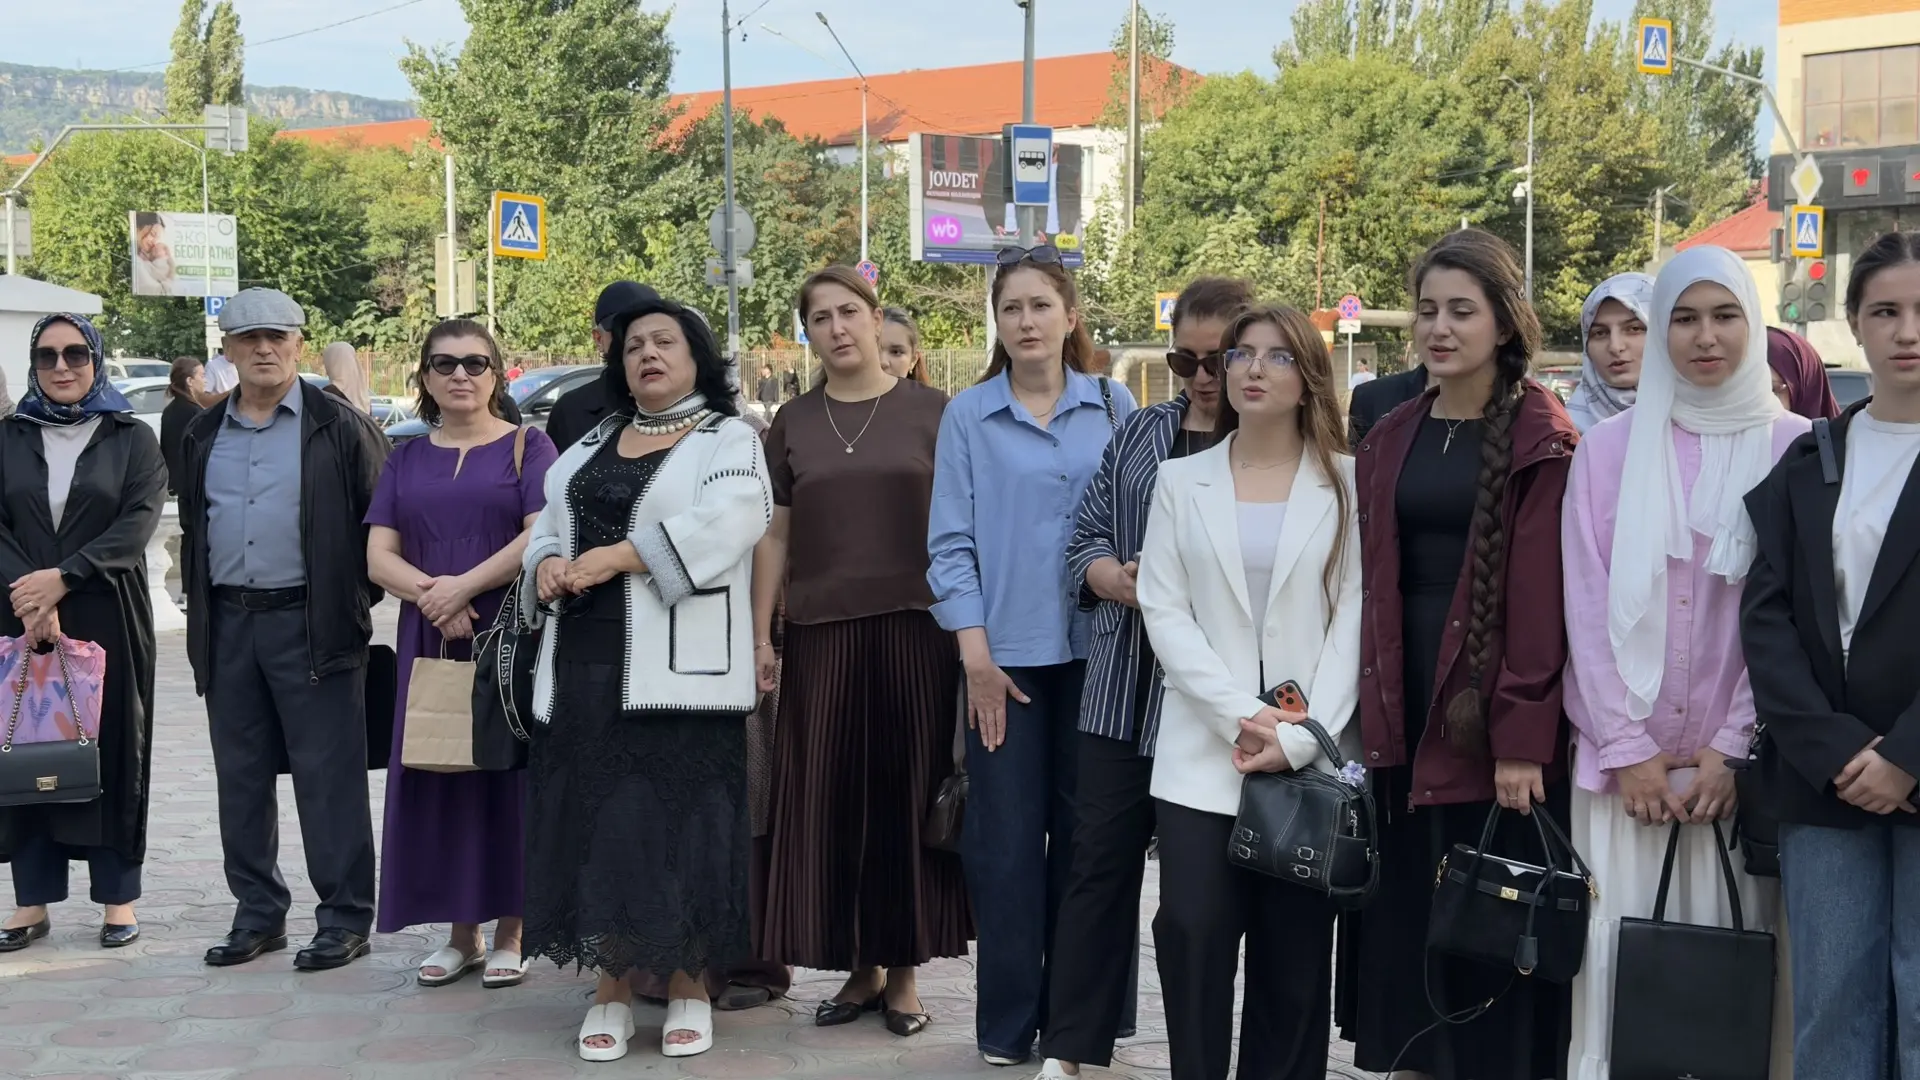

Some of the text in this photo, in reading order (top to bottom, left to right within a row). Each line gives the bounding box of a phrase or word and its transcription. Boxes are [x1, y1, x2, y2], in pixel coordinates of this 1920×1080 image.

[929, 170, 979, 189] JOVDET
[174, 230, 206, 244] ЭКО
[931, 218, 958, 239] wb
[210, 297, 223, 315] P
[501, 644, 512, 686] GUESS
